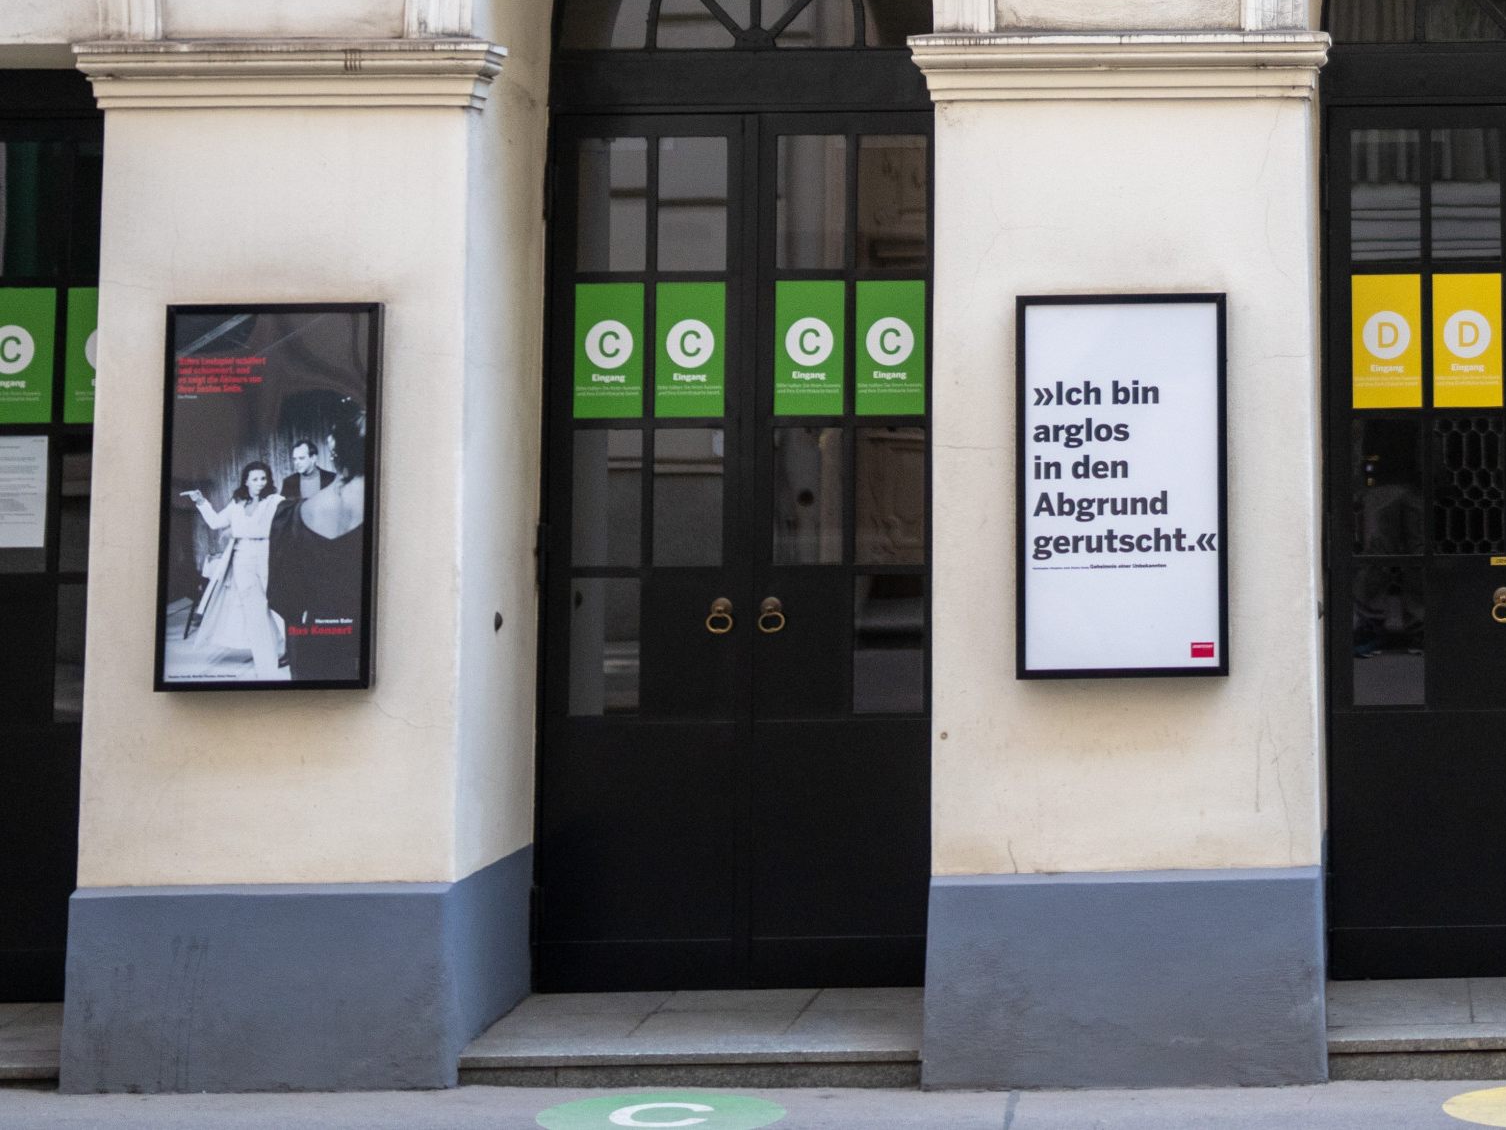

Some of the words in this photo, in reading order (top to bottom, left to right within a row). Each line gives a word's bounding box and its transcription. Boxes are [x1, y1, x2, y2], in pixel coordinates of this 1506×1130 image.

[599, 330, 620, 358] C
[679, 330, 701, 357] C
[799, 328, 821, 355] C
[879, 327, 901, 355] C
[1377, 322, 1399, 349] D
[1458, 321, 1479, 348] D
[0, 336, 21, 363] C
[592, 374, 625, 383] Eingang
[672, 373, 707, 382] Eingang
[792, 371, 826, 380] Eingang
[873, 371, 907, 380] Eingang
[1033, 380, 1100, 406] »Ich
[1112, 380, 1159, 405] bin
[1033, 417, 1130, 448] arglos
[1033, 455, 1061, 480] in
[1071, 454, 1129, 479] den
[1033, 490, 1168, 522] Abgrund
[1032, 527, 1217, 560] gerutscht.«
[608, 1102, 715, 1128] C
